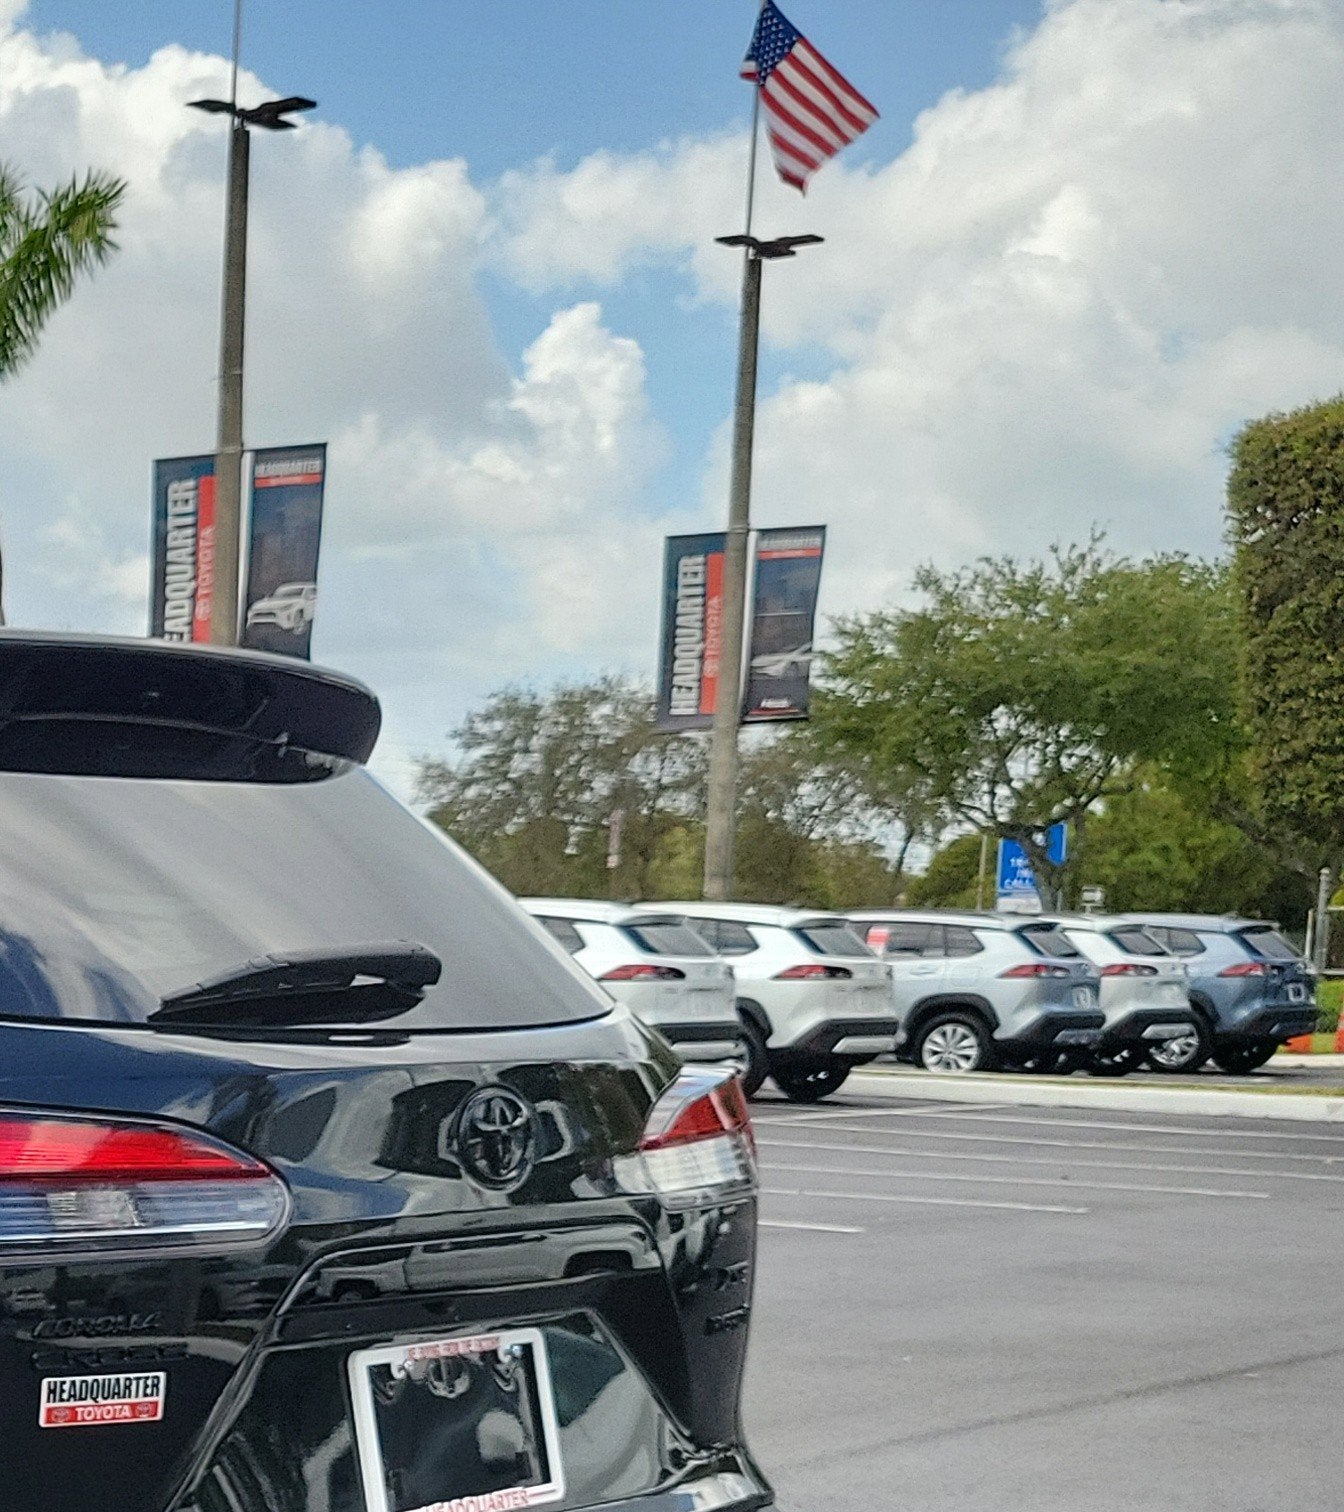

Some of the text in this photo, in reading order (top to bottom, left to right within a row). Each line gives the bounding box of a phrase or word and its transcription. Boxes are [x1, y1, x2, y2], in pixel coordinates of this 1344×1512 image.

[164, 479, 197, 642] EADQUARTER
[669, 555, 705, 715] HEADQUARTER
[46, 1374, 160, 1404] HEADQUARTER
[75, 1404, 133, 1421] TOYOTA
